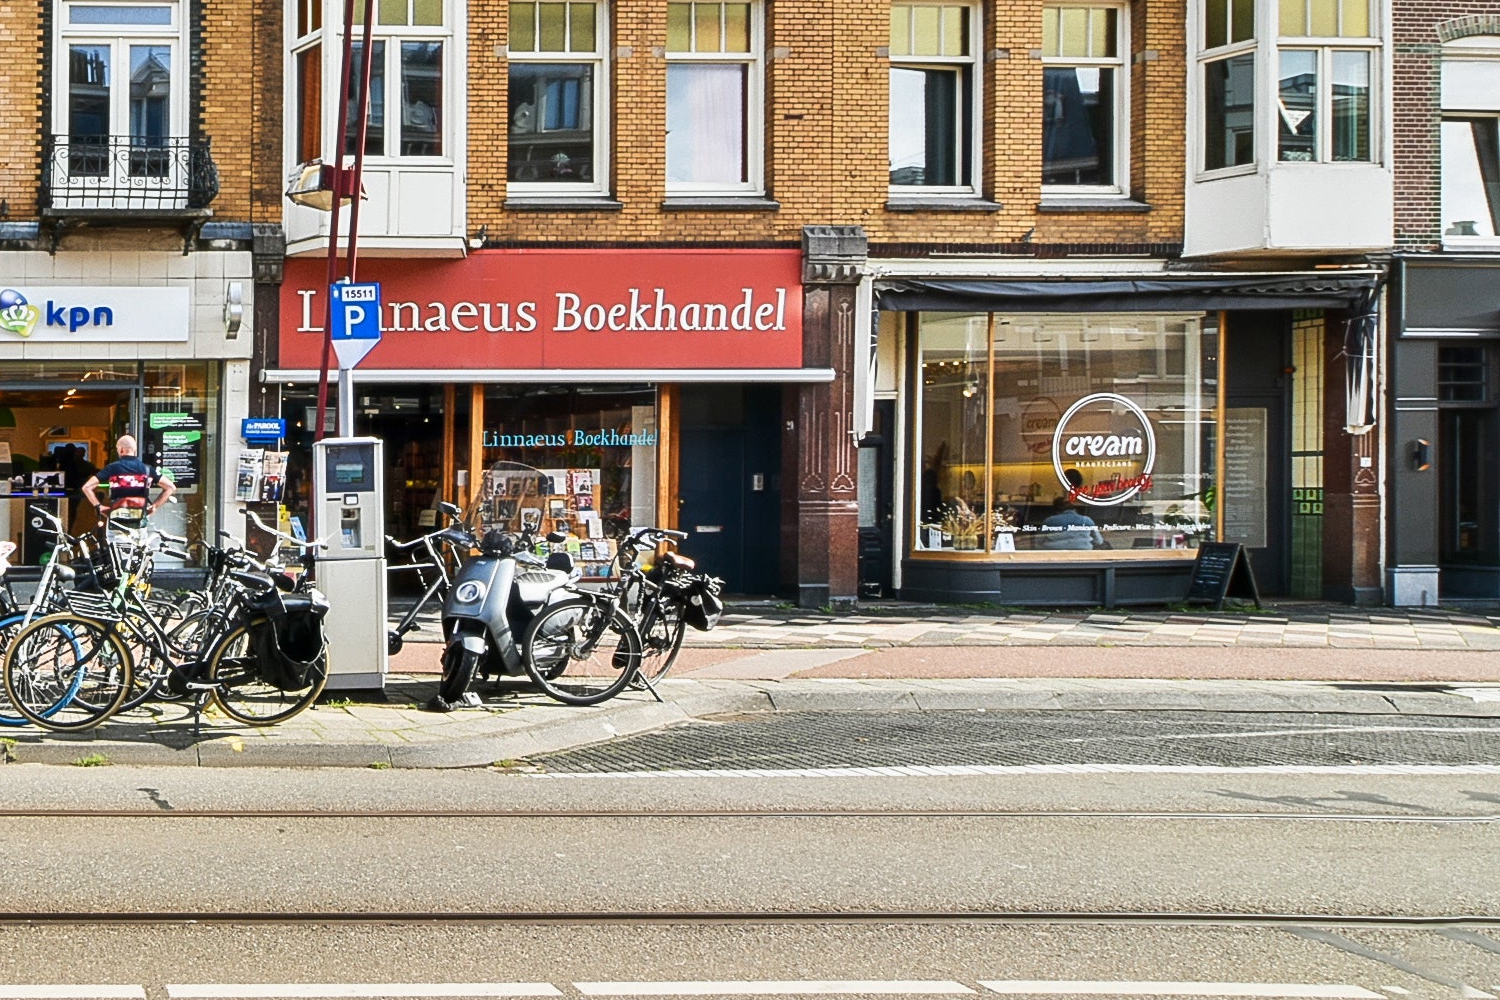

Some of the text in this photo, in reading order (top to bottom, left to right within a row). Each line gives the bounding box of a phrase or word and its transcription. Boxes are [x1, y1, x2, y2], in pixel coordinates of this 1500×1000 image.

[345, 290, 374, 299] 15511
[46, 300, 113, 332] kpn
[297, 288, 786, 332] Lnaeus Boekhandel
[345, 306, 365, 336] P
[483, 429, 657, 446] Linnaeus Boekhandel
[1066, 436, 1142, 456] cream
